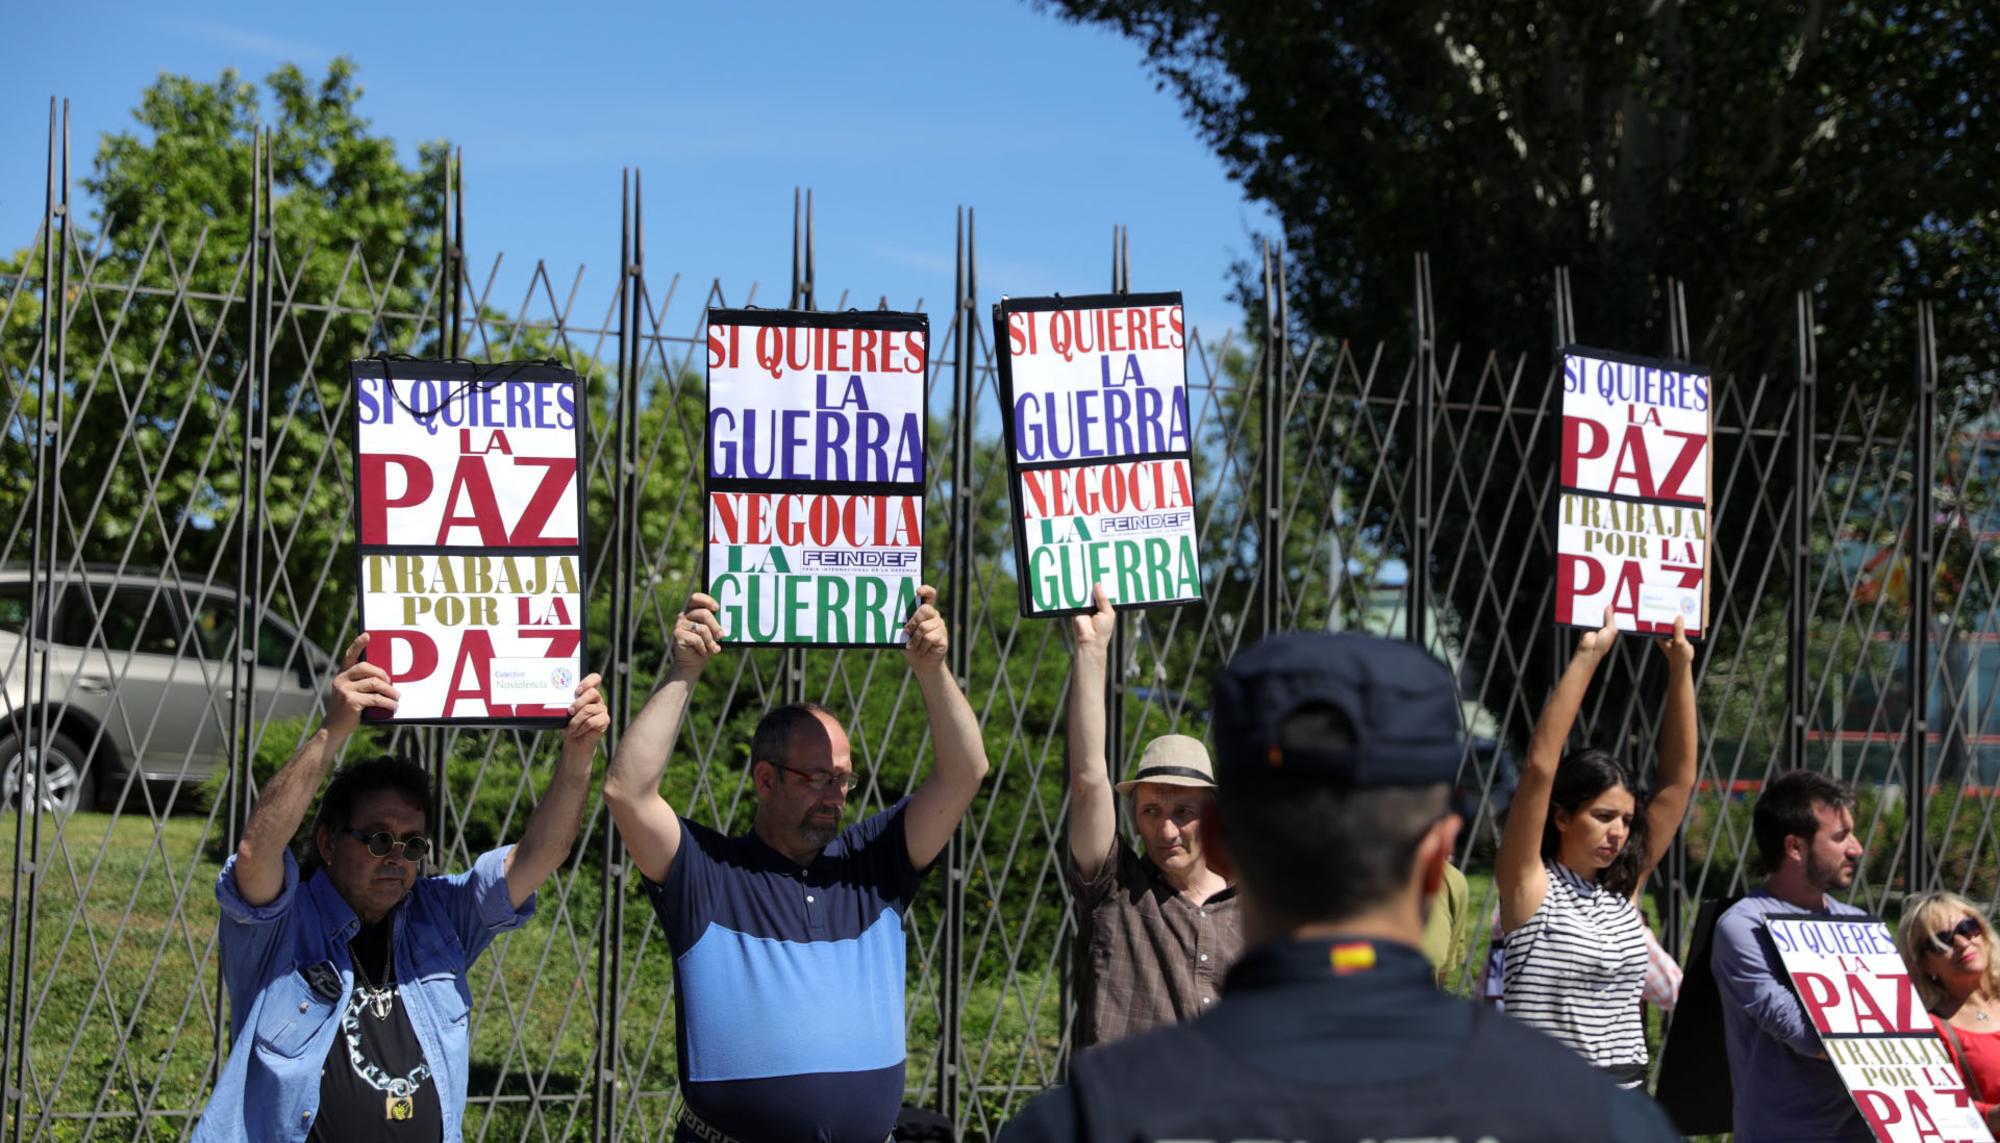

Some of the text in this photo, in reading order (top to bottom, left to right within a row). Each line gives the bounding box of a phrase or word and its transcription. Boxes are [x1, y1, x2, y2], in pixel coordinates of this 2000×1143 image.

[708, 324, 925, 379] SI QUIERES
[1008, 306, 1184, 362] SI QUIERES
[1100, 354, 1145, 388] LA
[1564, 354, 1708, 412] SI QUIERES
[358, 378, 575, 435] SI QUIERES
[816, 374, 869, 410] LA
[1014, 385, 1190, 461] GUERRA
[1628, 404, 1662, 427] LA
[460, 429, 513, 455] LA
[710, 407, 922, 483] GUERRA
[1560, 415, 1708, 503] PAZ
[360, 453, 578, 546] PAZ
[1021, 460, 1193, 519] NEGOCIA
[711, 492, 922, 547] NEGOCIA
[1040, 516, 1093, 544] LA
[1101, 512, 1190, 532] FEINDEF
[1561, 493, 1705, 540] TRABAJA
[725, 545, 792, 573] LA
[803, 551, 917, 566] FEINDEF
[1584, 530, 1697, 564] POR LA
[362, 556, 580, 594] TRABAJA
[1029, 535, 1200, 611] GUERRA
[401, 596, 573, 626] POR LA
[710, 574, 921, 643] GUERRA
[1770, 920, 1899, 959] SI QUIERES
[1838, 956, 1870, 972] LA
[1791, 972, 1936, 1033] PAZ
[1826, 1038, 1953, 1065] TRABAJA
[1861, 1067, 1957, 1087] POR LA
